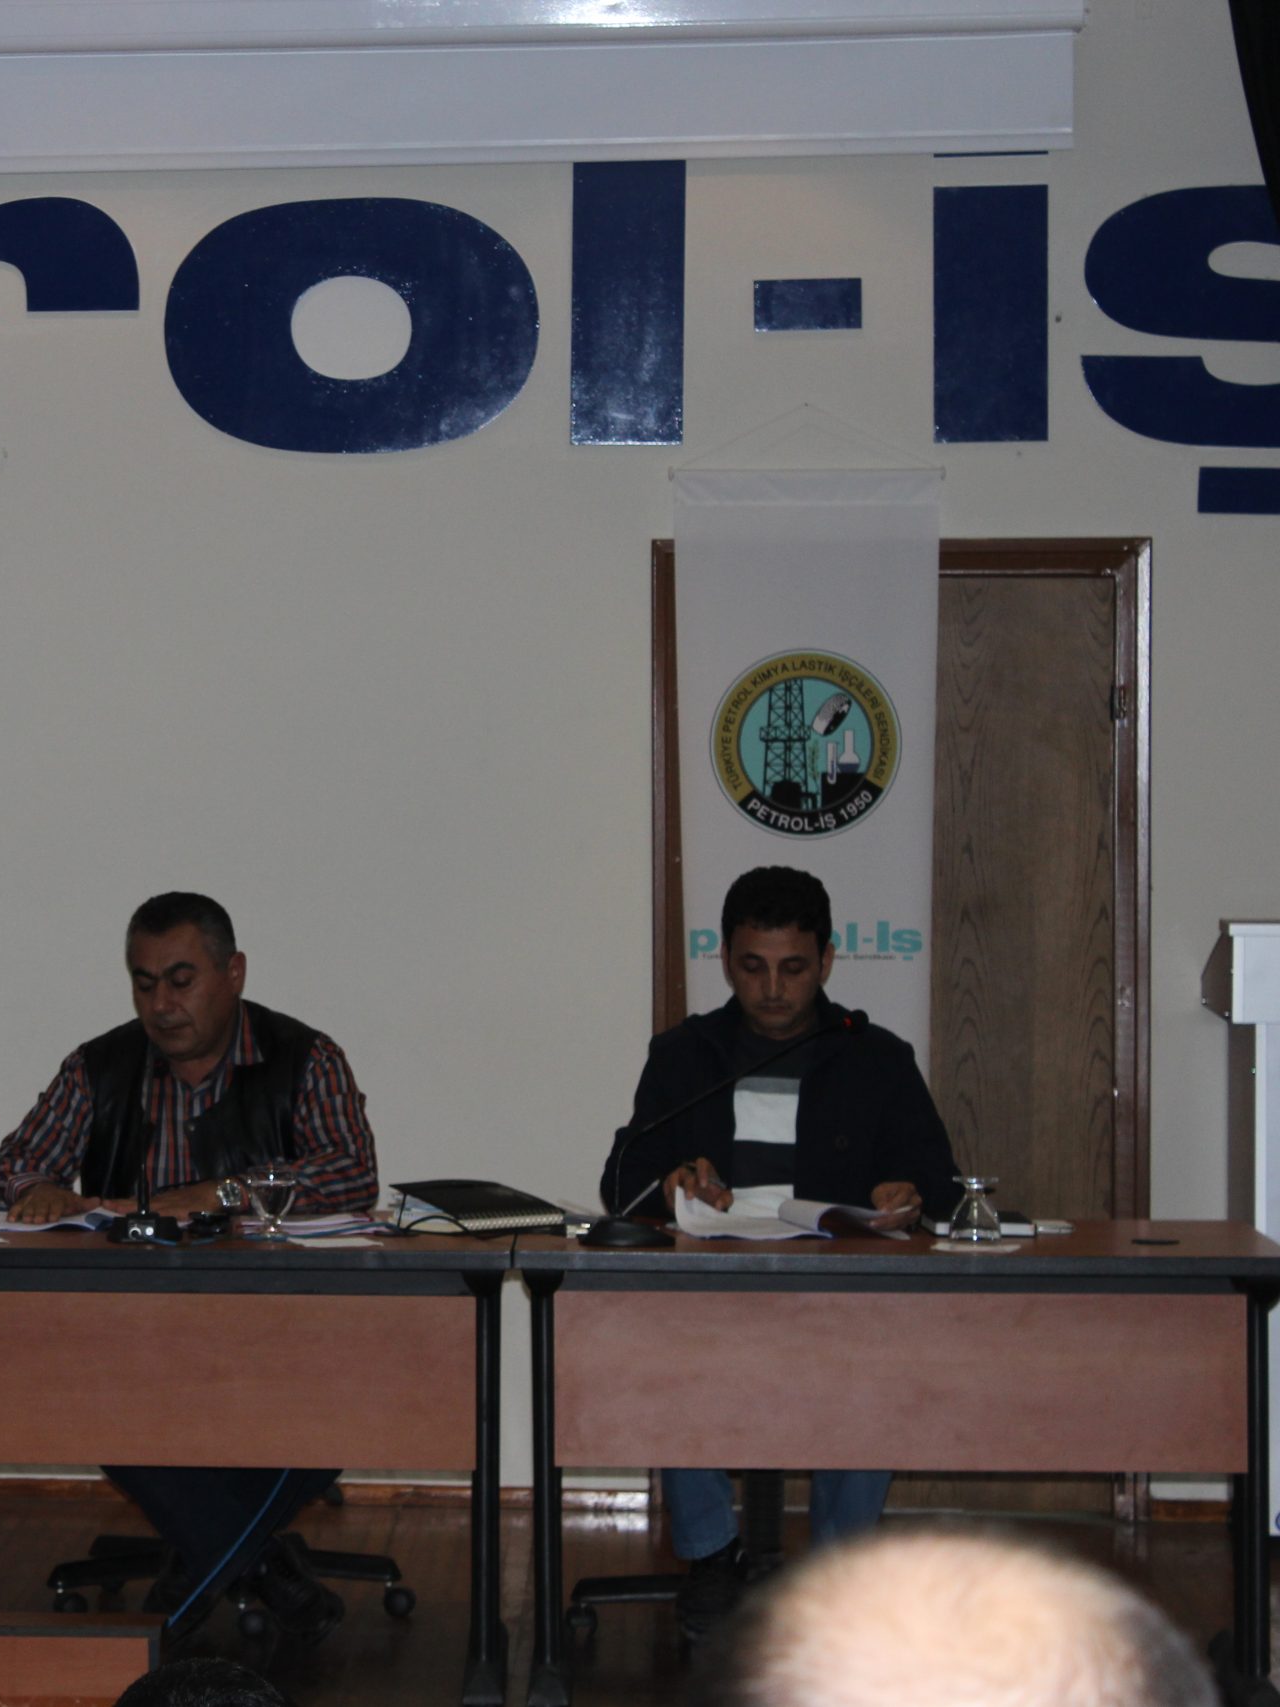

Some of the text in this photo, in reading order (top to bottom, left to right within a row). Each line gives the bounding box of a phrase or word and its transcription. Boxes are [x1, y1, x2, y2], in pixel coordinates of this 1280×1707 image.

[751, 662, 790, 688] KİMYA
[792, 659, 837, 674] LASTİK
[723, 688, 751, 733] PETROL
[720, 734, 745, 791] TÜRKİYE
[746, 789, 875, 833] PETROL-İŞ 1950
